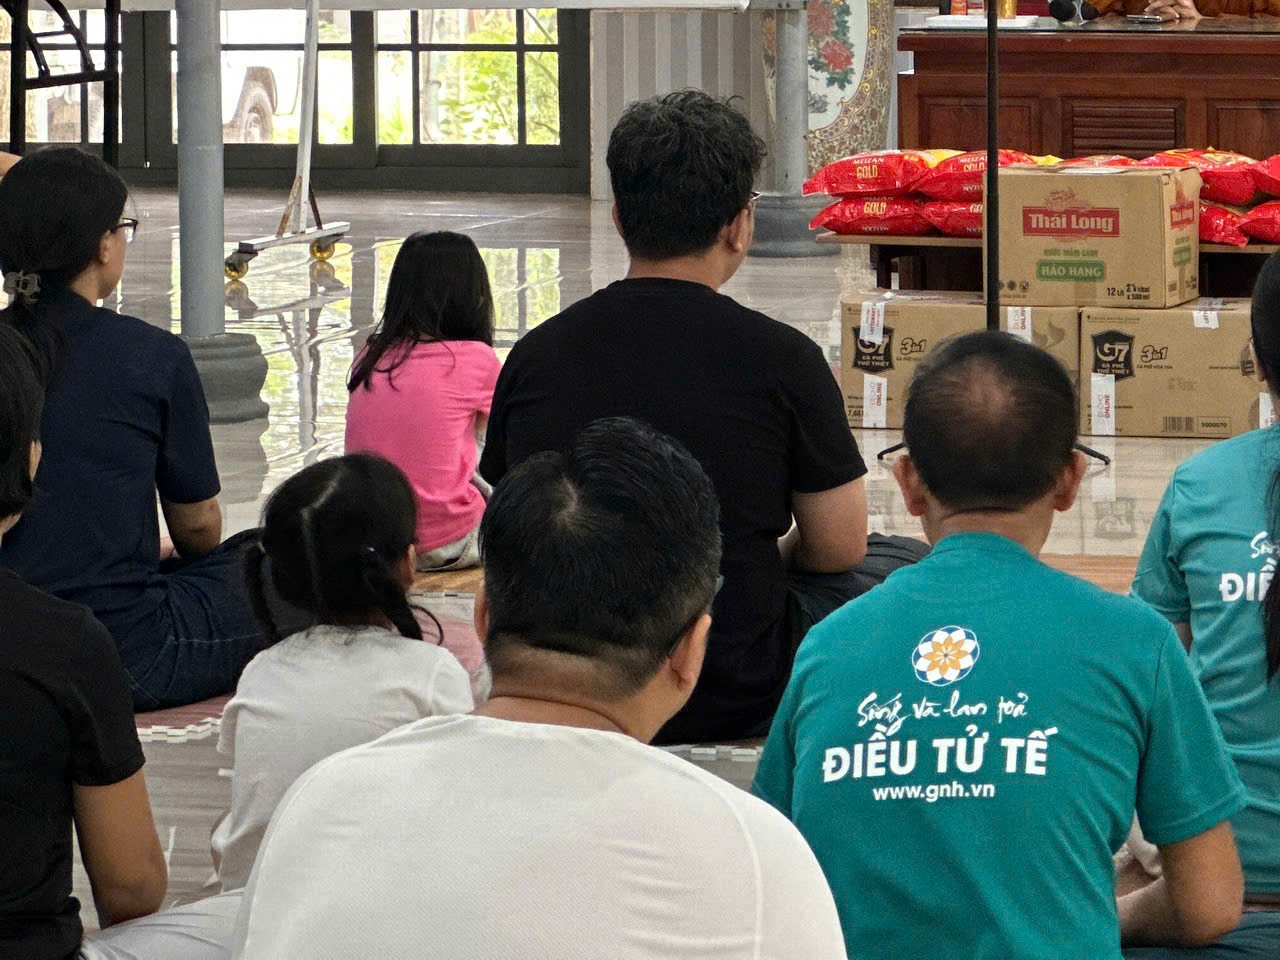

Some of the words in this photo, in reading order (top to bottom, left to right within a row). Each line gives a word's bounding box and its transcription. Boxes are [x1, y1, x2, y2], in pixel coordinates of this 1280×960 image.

[853, 157, 885, 165] MEIZAN
[856, 165, 878, 179] GOLD
[864, 201, 887, 214] GOLD
[1029, 208, 1067, 228] Thái
[1071, 214, 1114, 232] Long
[1107, 287, 1116, 297] 12
[900, 337, 927, 355] 3in1
[1096, 342, 1130, 362] G7
[1141, 345, 1168, 363] 3in1
[1219, 556, 1278, 602] ĐIỀ
[857, 691, 913, 736] Sống
[943, 690, 988, 718] lan
[822, 723, 917, 783] ĐIỀU
[932, 724, 989, 773] TỬ
[1000, 727, 1059, 776] TẾ
[872, 781, 995, 803] www.gnh.vn
